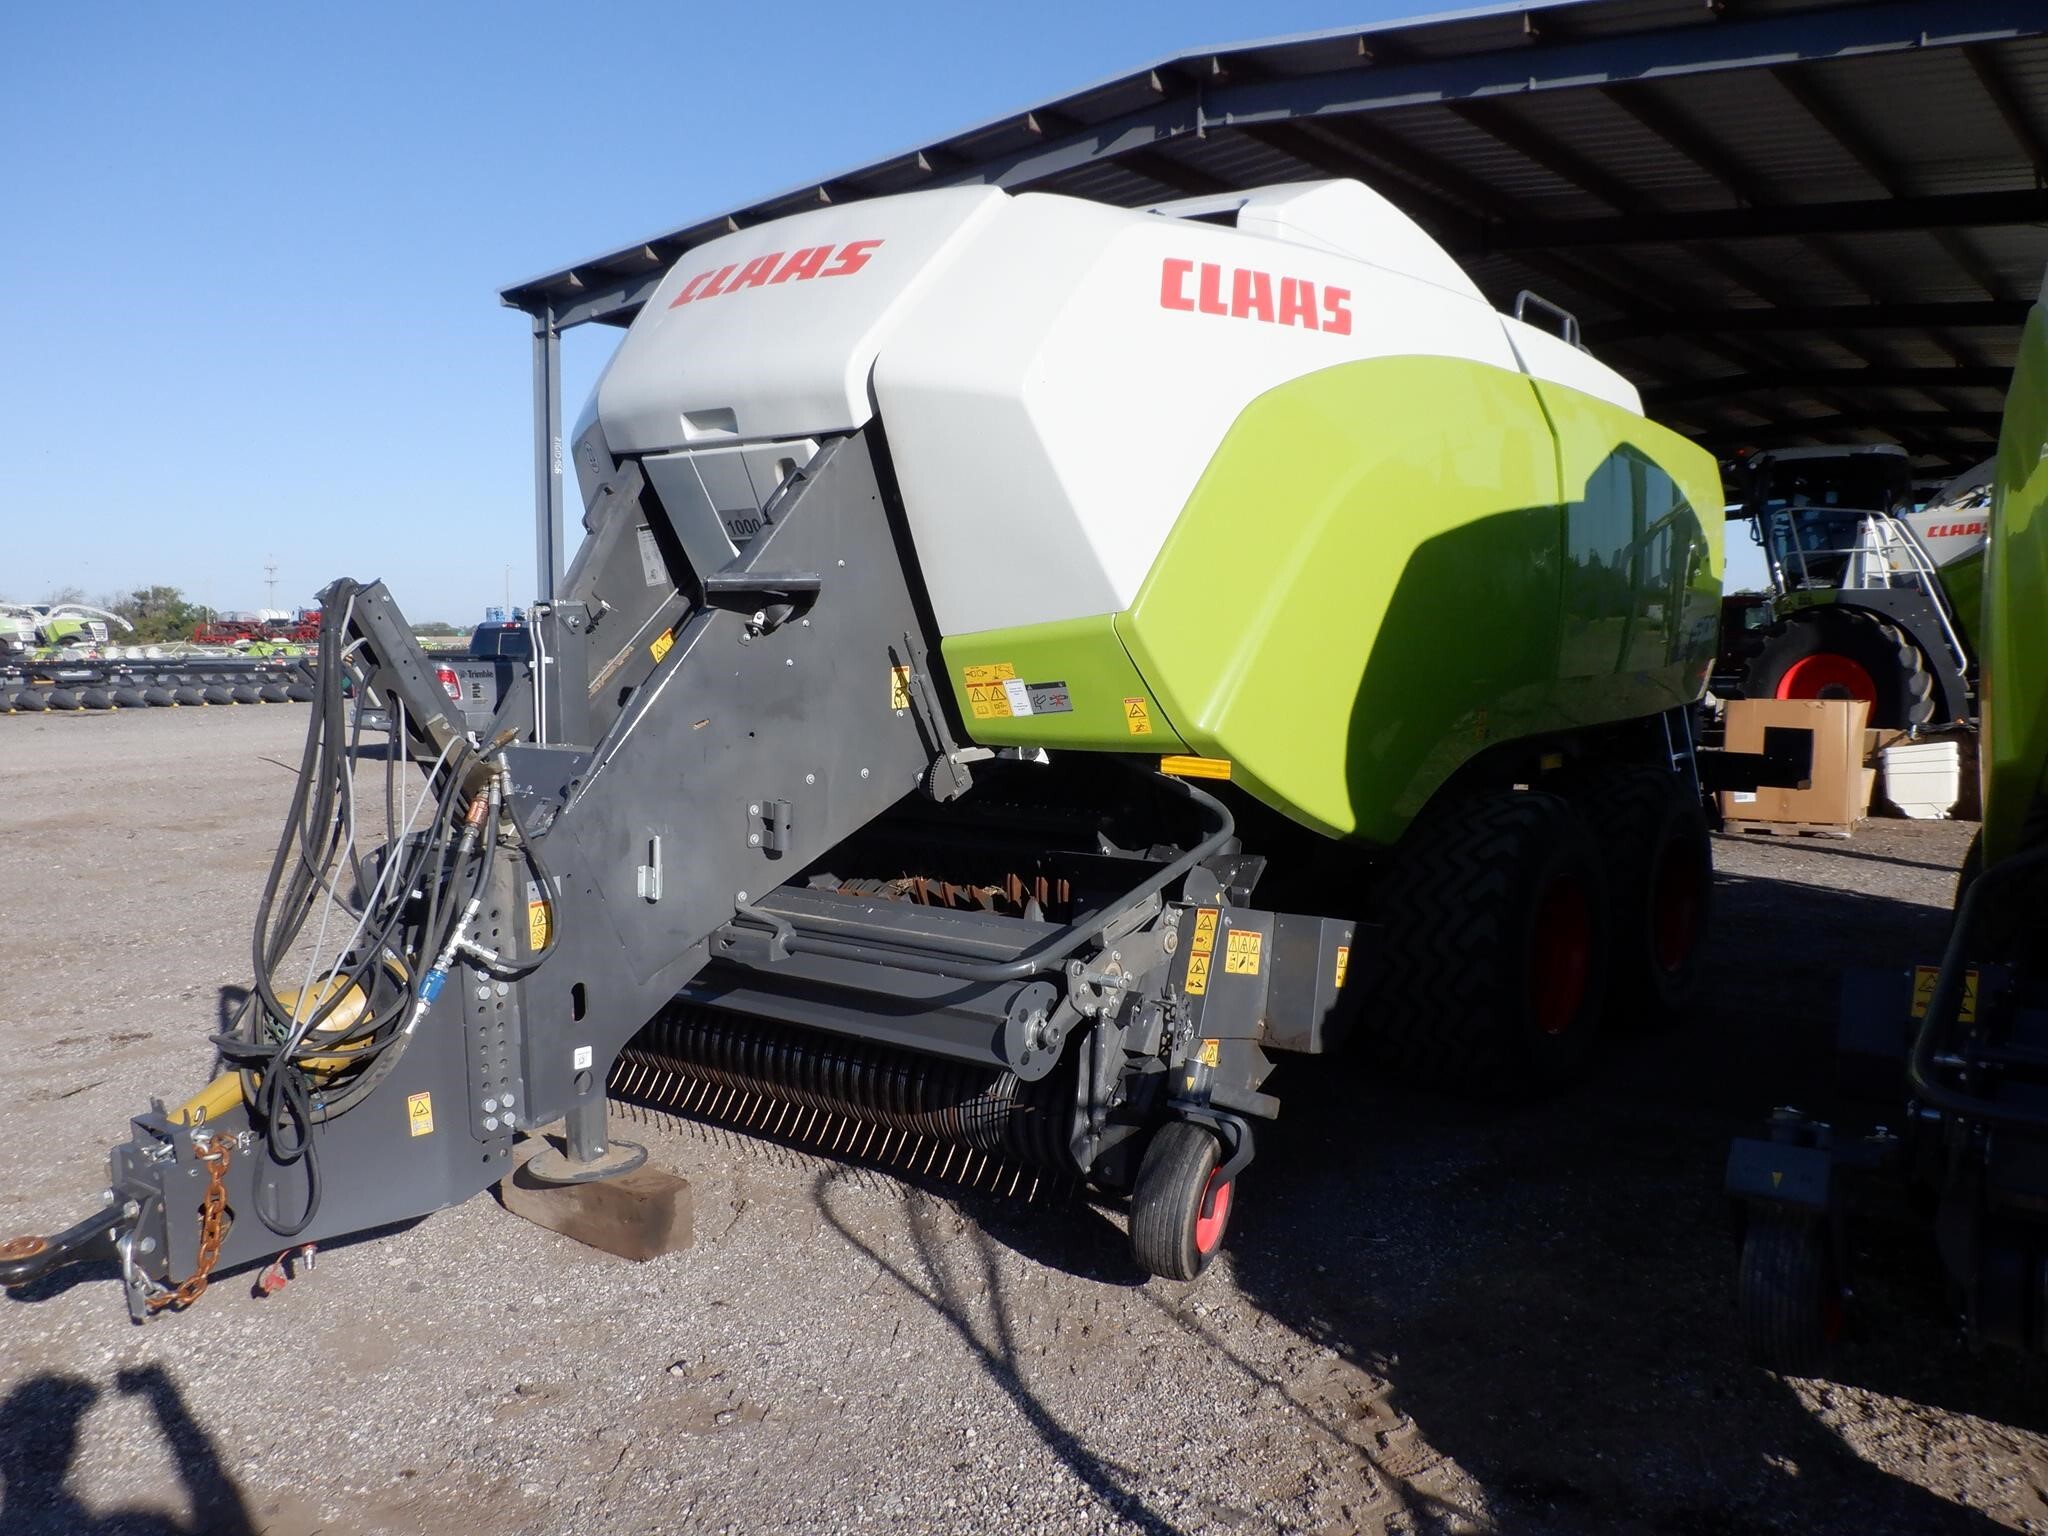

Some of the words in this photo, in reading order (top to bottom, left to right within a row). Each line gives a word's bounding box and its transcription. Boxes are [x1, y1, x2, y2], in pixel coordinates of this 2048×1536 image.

[669, 239, 884, 309] CLAAS
[1160, 257, 1352, 335] CLAAS
[727, 518, 761, 535] 1000
[467, 669, 494, 678] Trimble
